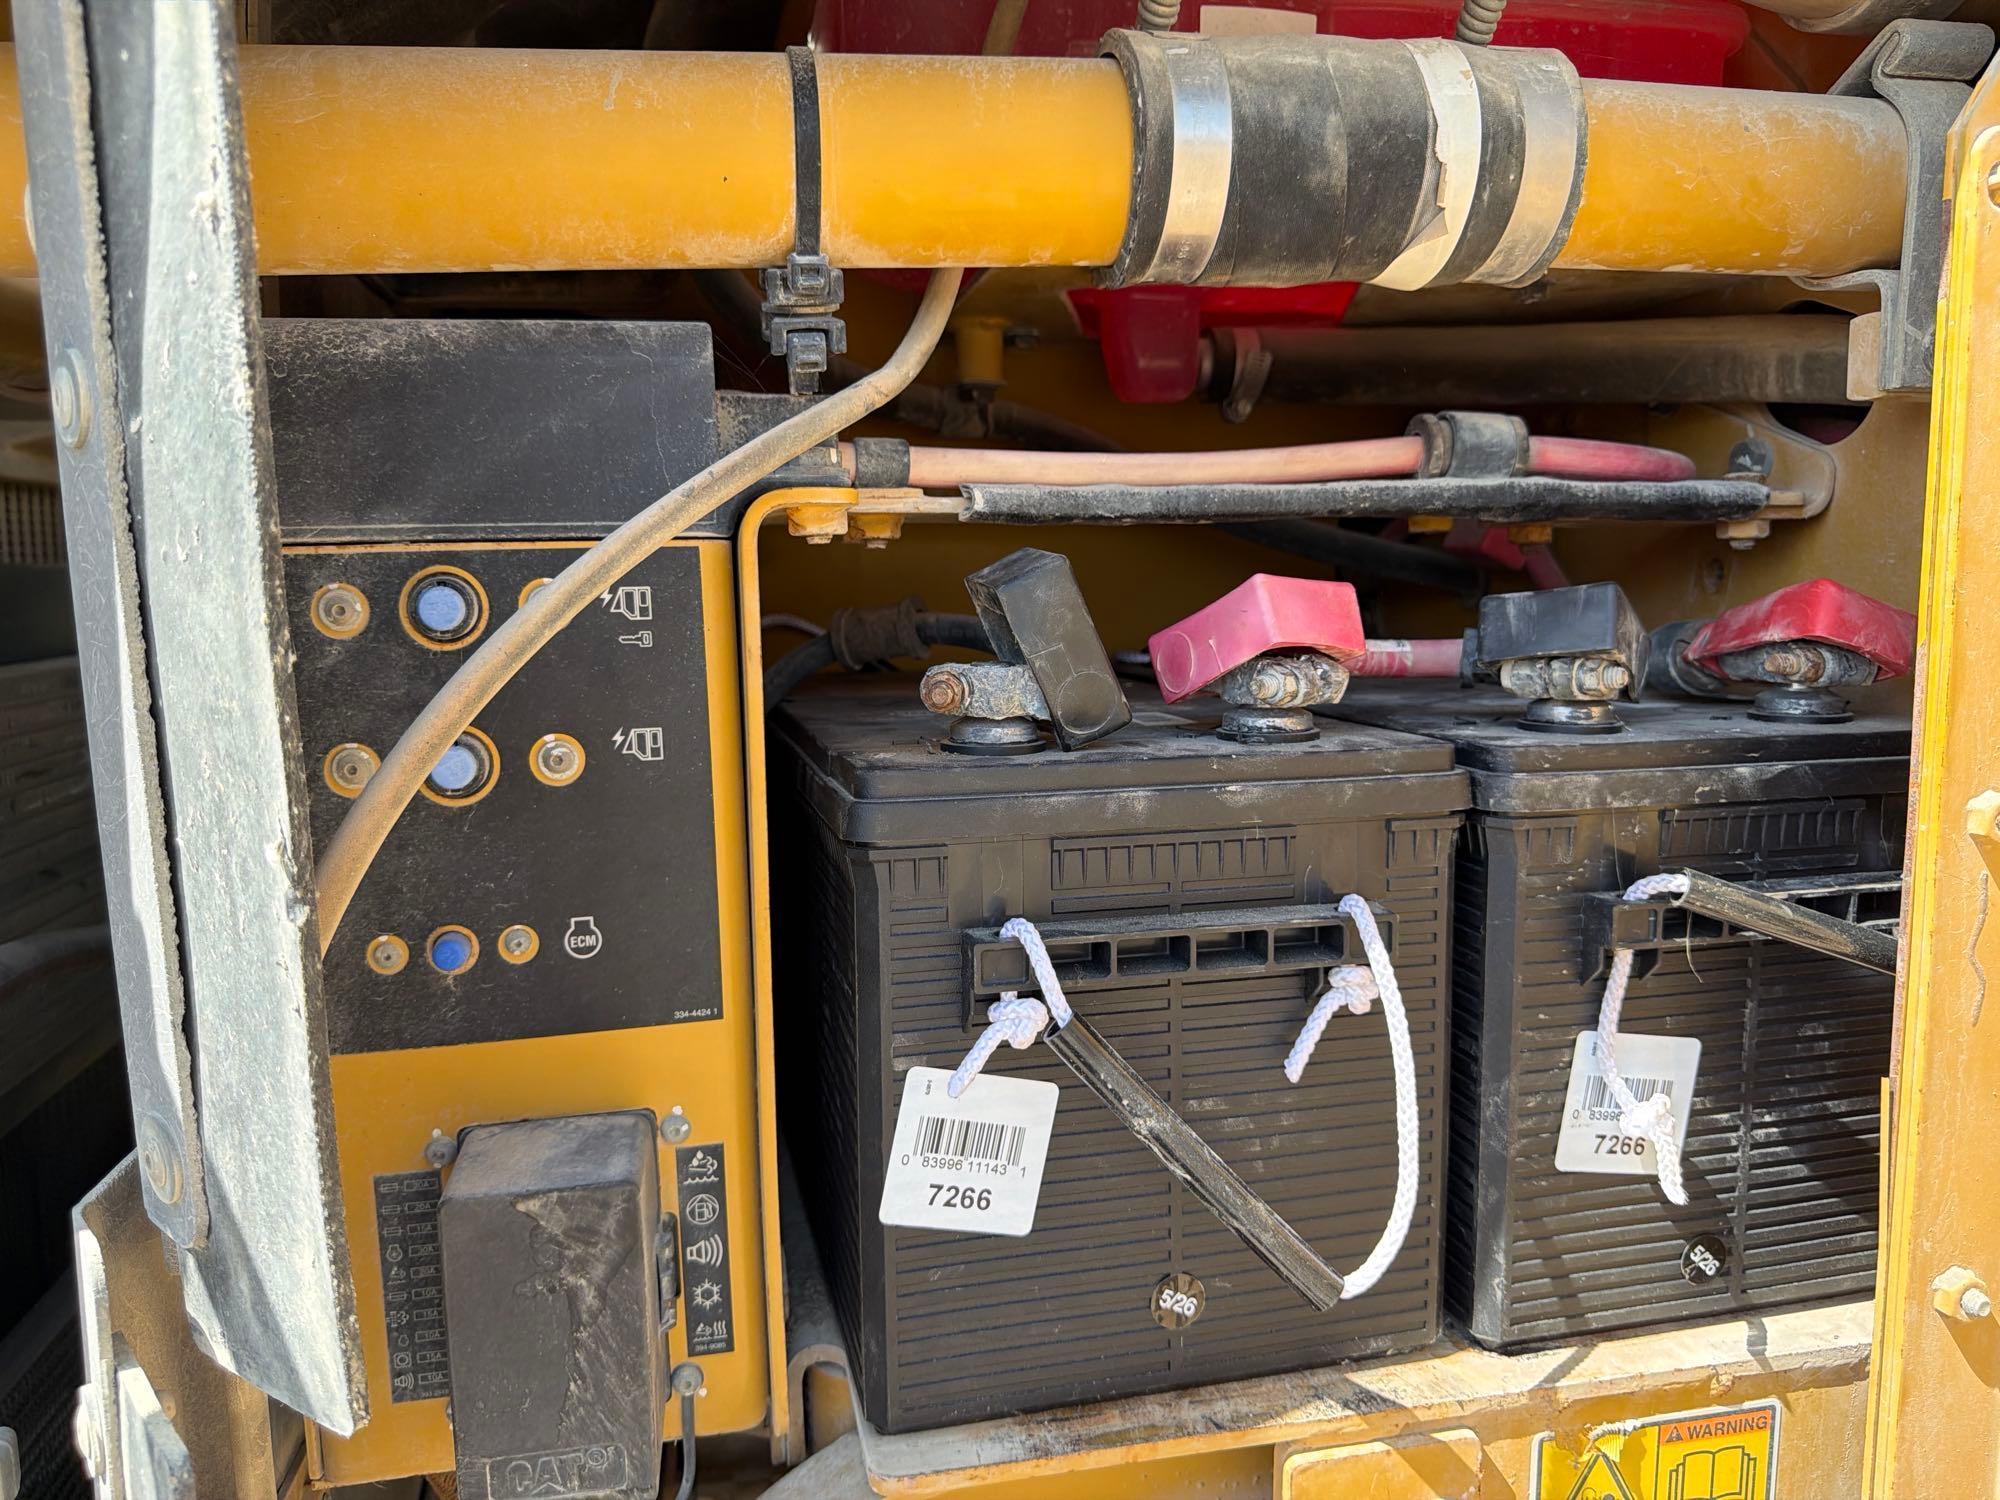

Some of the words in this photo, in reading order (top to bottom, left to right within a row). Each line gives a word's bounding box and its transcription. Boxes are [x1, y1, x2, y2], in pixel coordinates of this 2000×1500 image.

[570, 934, 597, 948] ECM
[673, 1008, 711, 1019] 334-4424
[1572, 1109, 1580, 1120] 0
[1593, 1134, 1646, 1156] 7266
[901, 1154, 910, 1166] 0
[921, 1156, 963, 1171] 83996
[967, 1161, 1008, 1176] 11143
[1019, 1166, 1027, 1178] 1
[928, 1183, 992, 1211] 7266
[1690, 1244, 1720, 1276] 5/26
[1159, 1288, 1198, 1318] 5/26
[1686, 1415, 1768, 1440] WARNING
